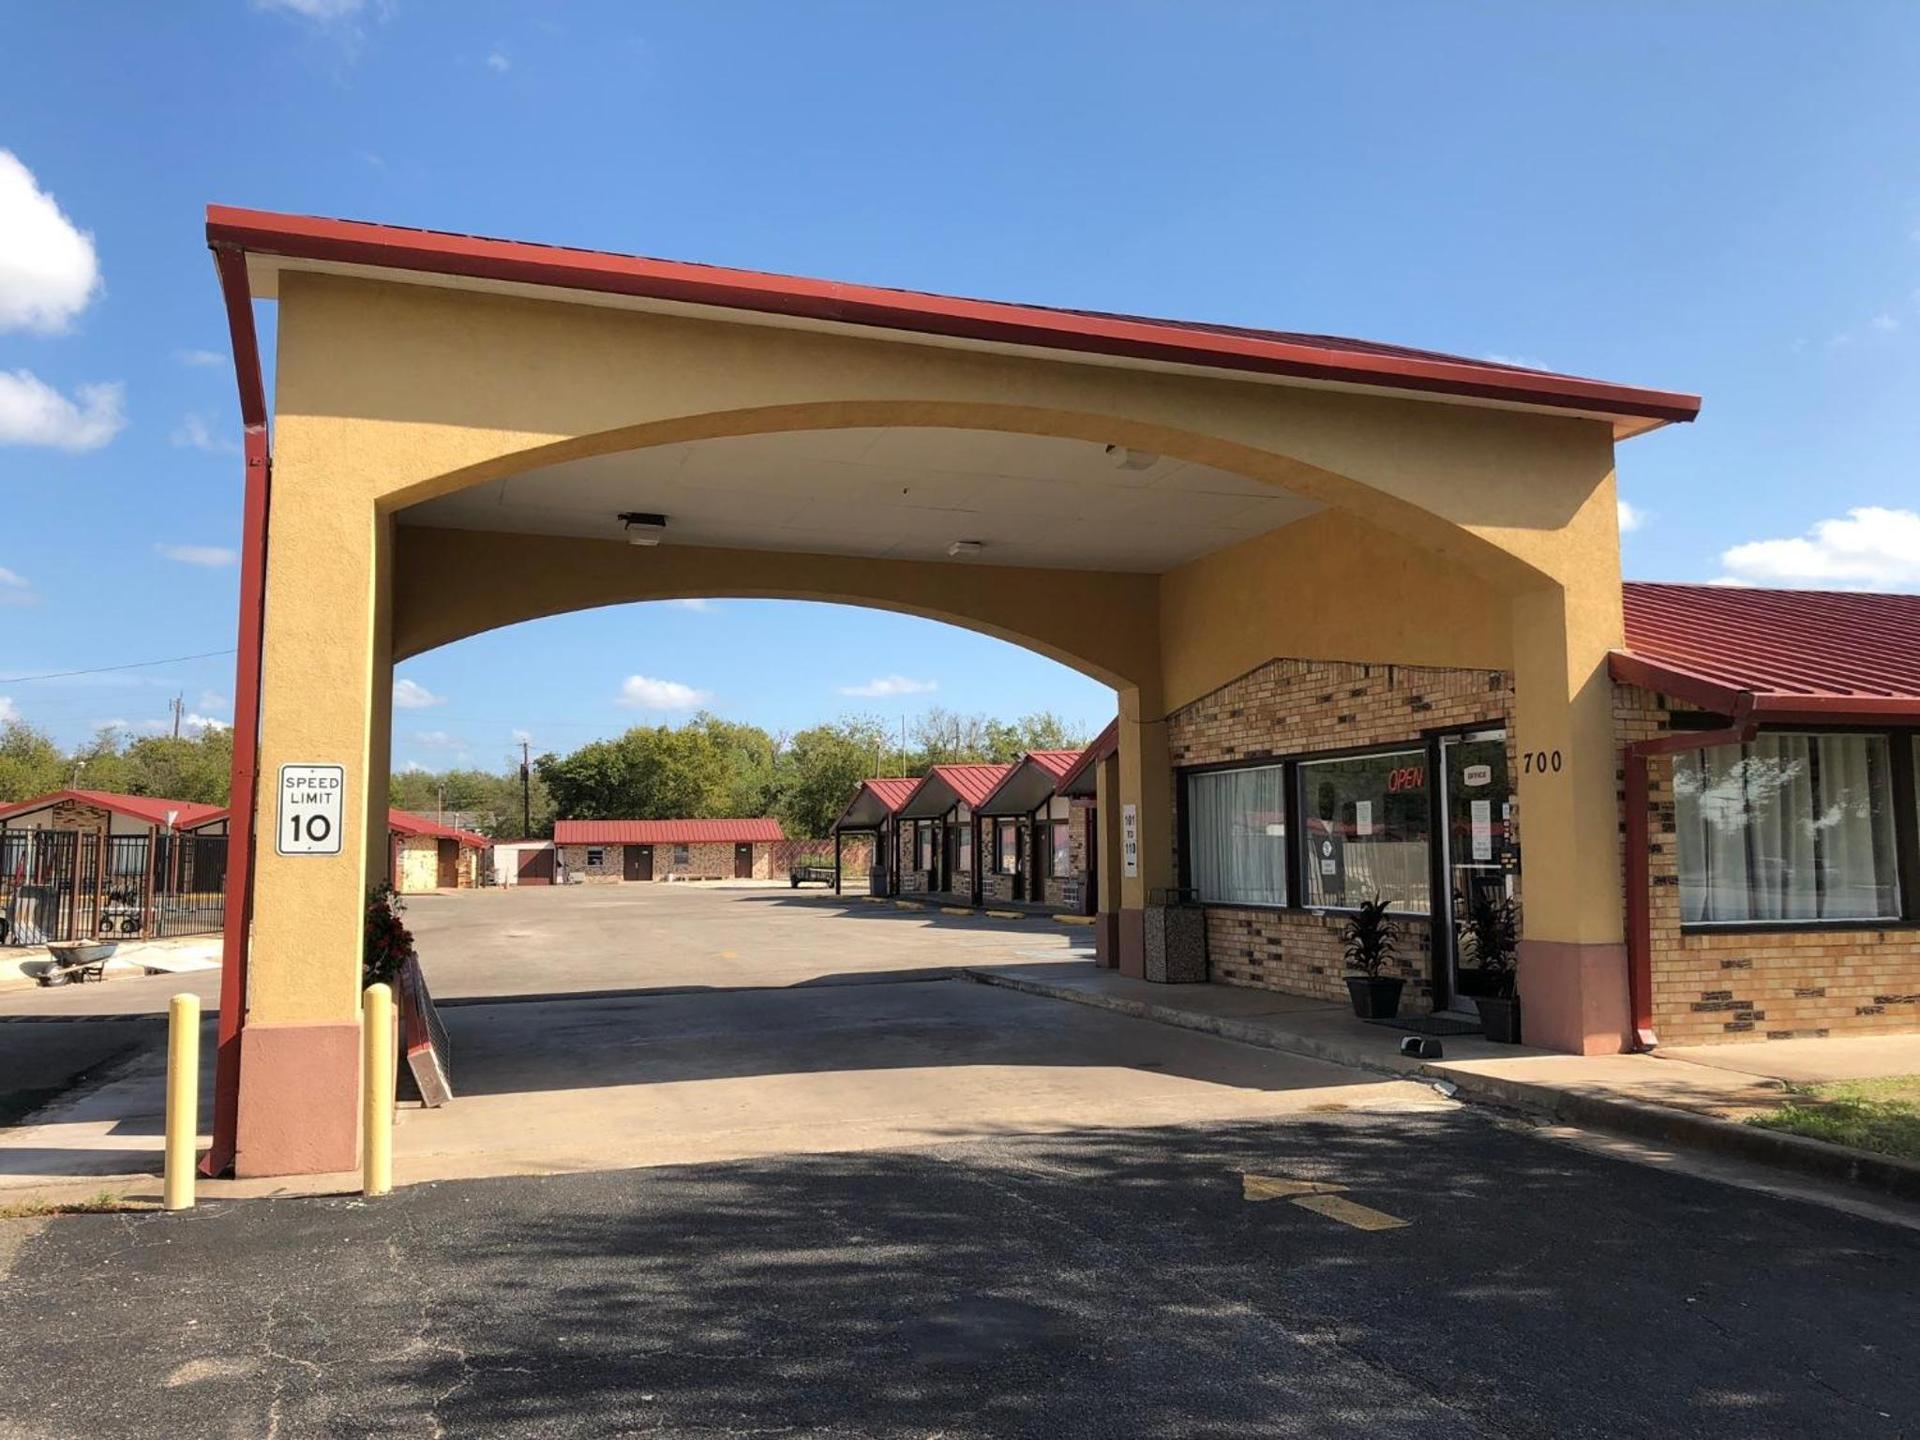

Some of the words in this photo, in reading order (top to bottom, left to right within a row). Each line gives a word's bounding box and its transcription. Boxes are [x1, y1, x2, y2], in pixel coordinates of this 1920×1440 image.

[1523, 750, 1562, 774] 700
[285, 777, 339, 789] SPEED
[1388, 767, 1424, 792] OPEN
[1467, 771, 1487, 780] OFFICE
[290, 792, 333, 804] LIMIT
[290, 814, 331, 842] 10
